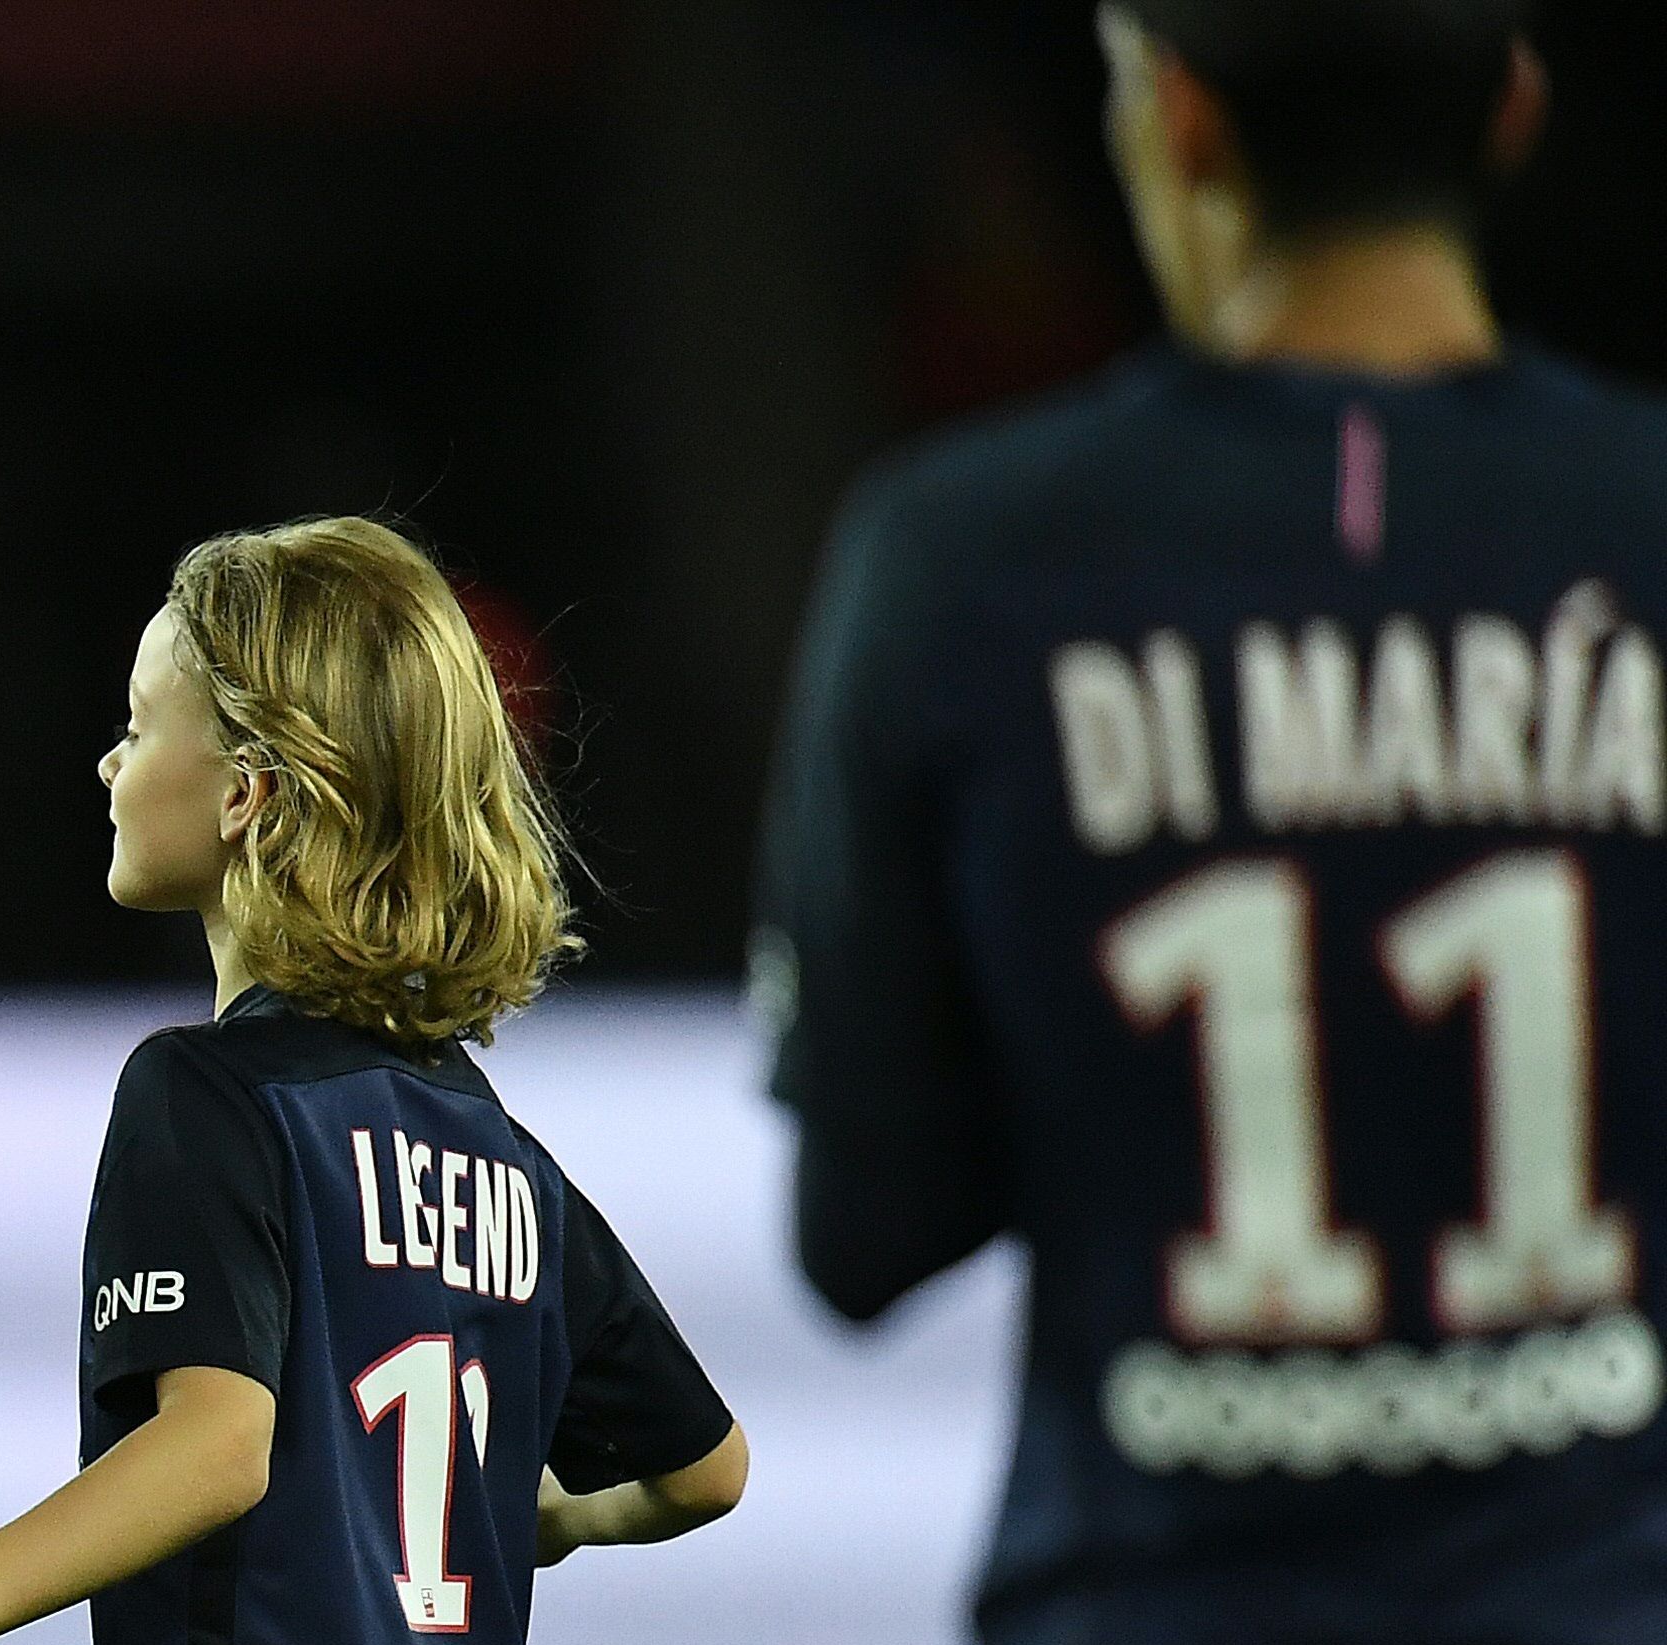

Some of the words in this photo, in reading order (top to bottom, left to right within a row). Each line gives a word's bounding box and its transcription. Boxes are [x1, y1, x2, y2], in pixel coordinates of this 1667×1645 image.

[1049, 632, 1221, 854] DI
[1237, 580, 1667, 836] MARÍA
[1099, 850, 1639, 1346] 11
[94, 1270, 185, 1332] QNB
